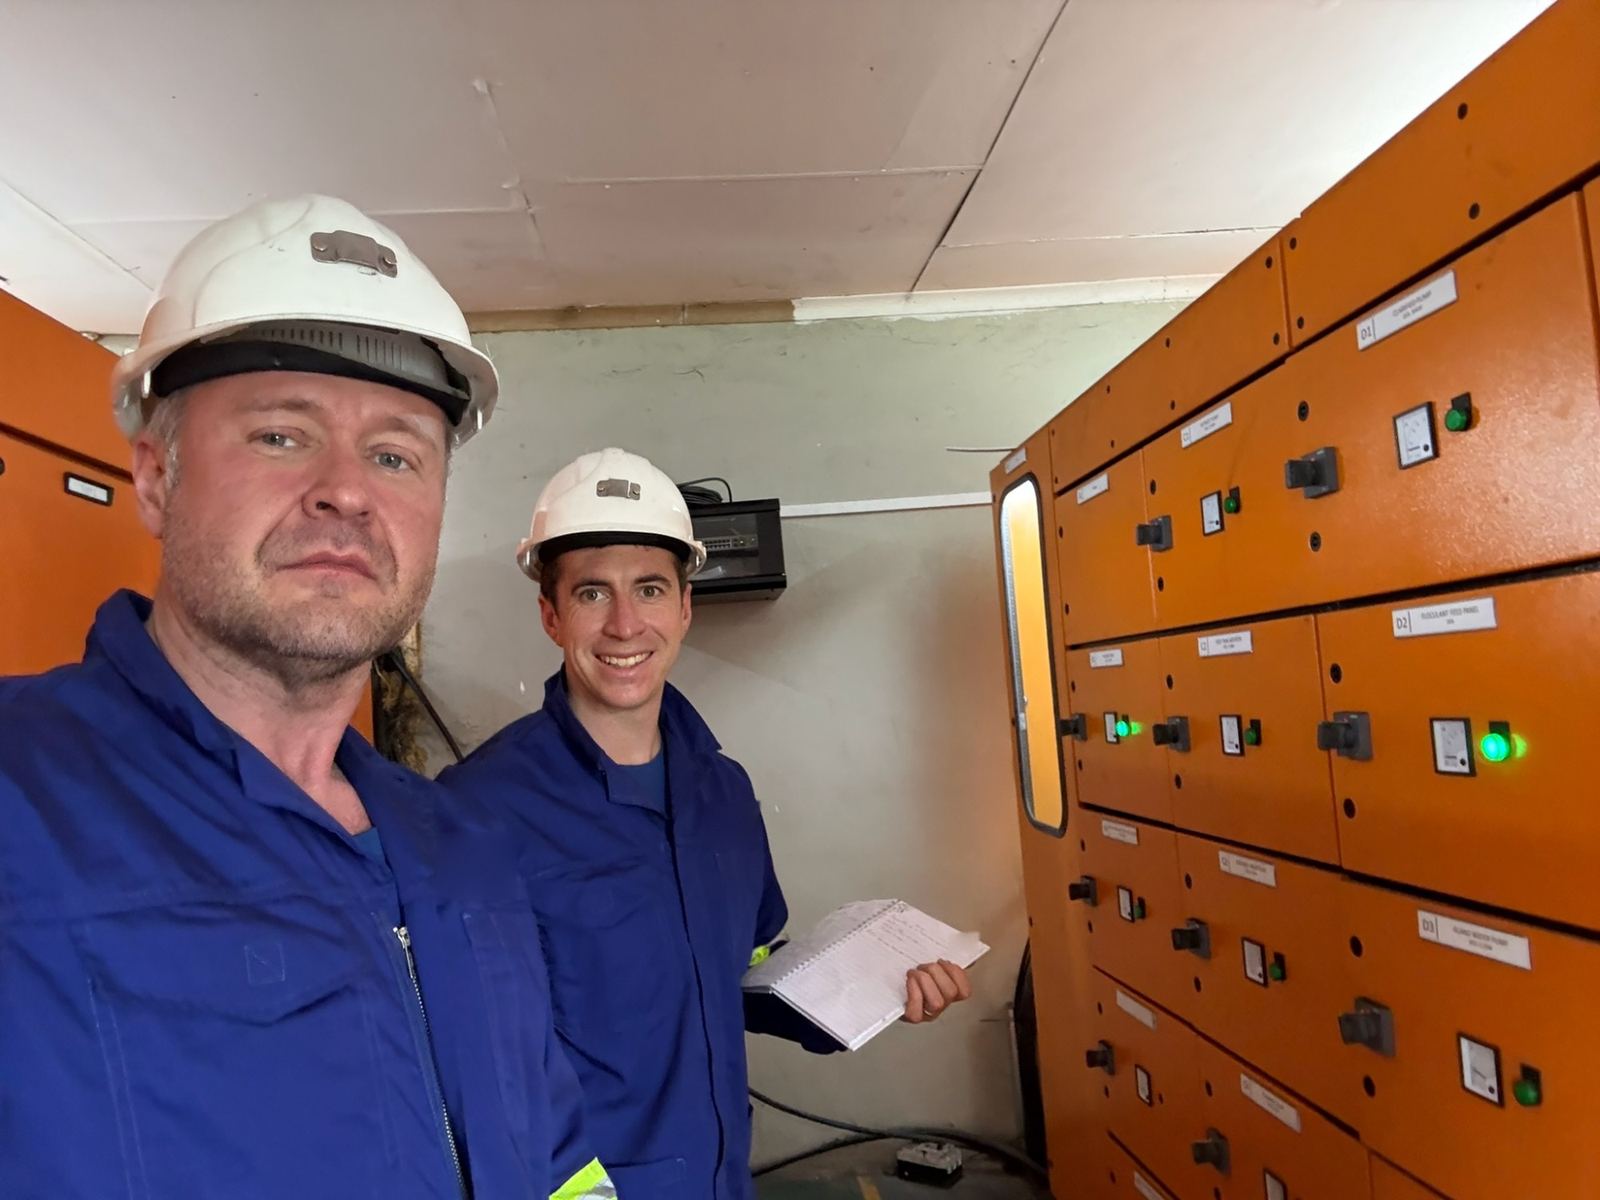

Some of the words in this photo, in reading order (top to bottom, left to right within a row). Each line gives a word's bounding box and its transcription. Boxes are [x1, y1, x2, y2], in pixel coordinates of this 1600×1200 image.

[1361, 326, 1372, 340] D1
[1396, 617, 1408, 630] D2
[1422, 919, 1435, 932] D3
